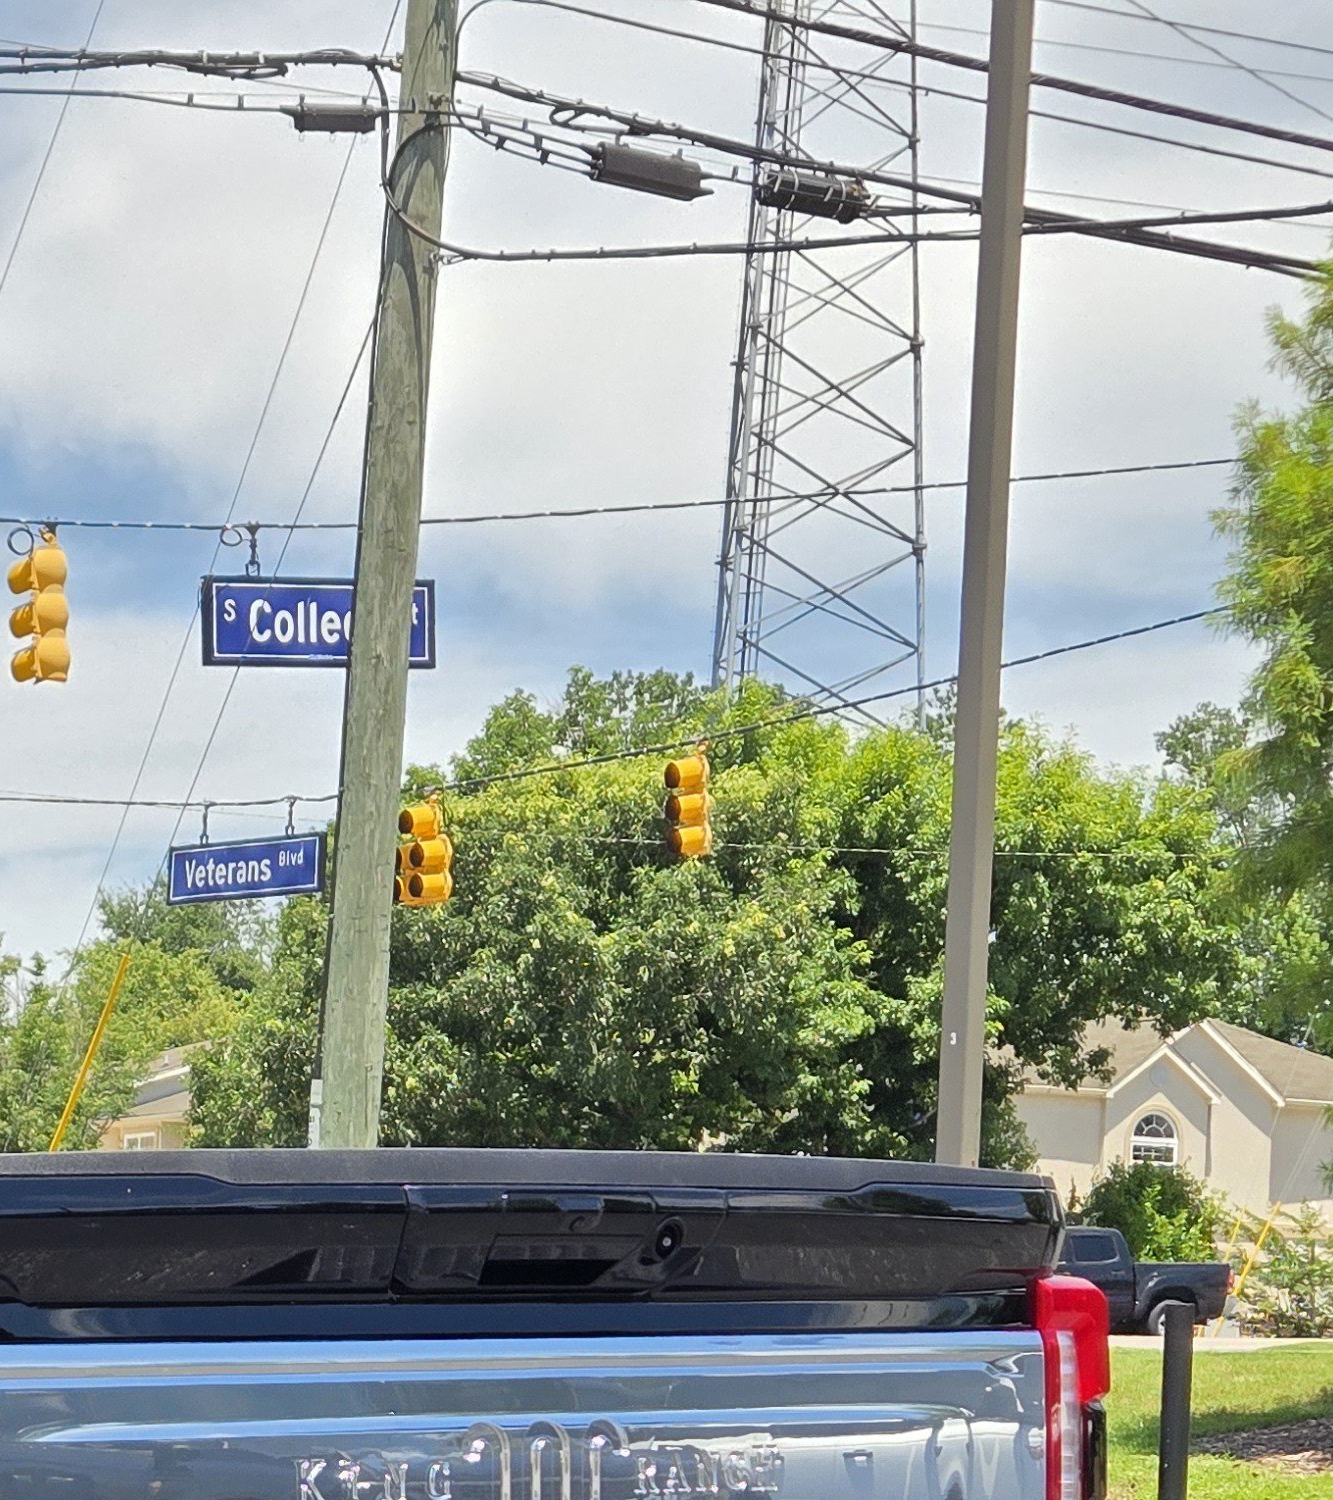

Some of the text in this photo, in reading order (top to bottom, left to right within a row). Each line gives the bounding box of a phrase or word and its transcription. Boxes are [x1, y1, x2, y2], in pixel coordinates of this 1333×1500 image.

[223, 598, 236, 622] S
[249, 599, 351, 644] Colle
[185, 847, 304, 889] Veterans Blvd
